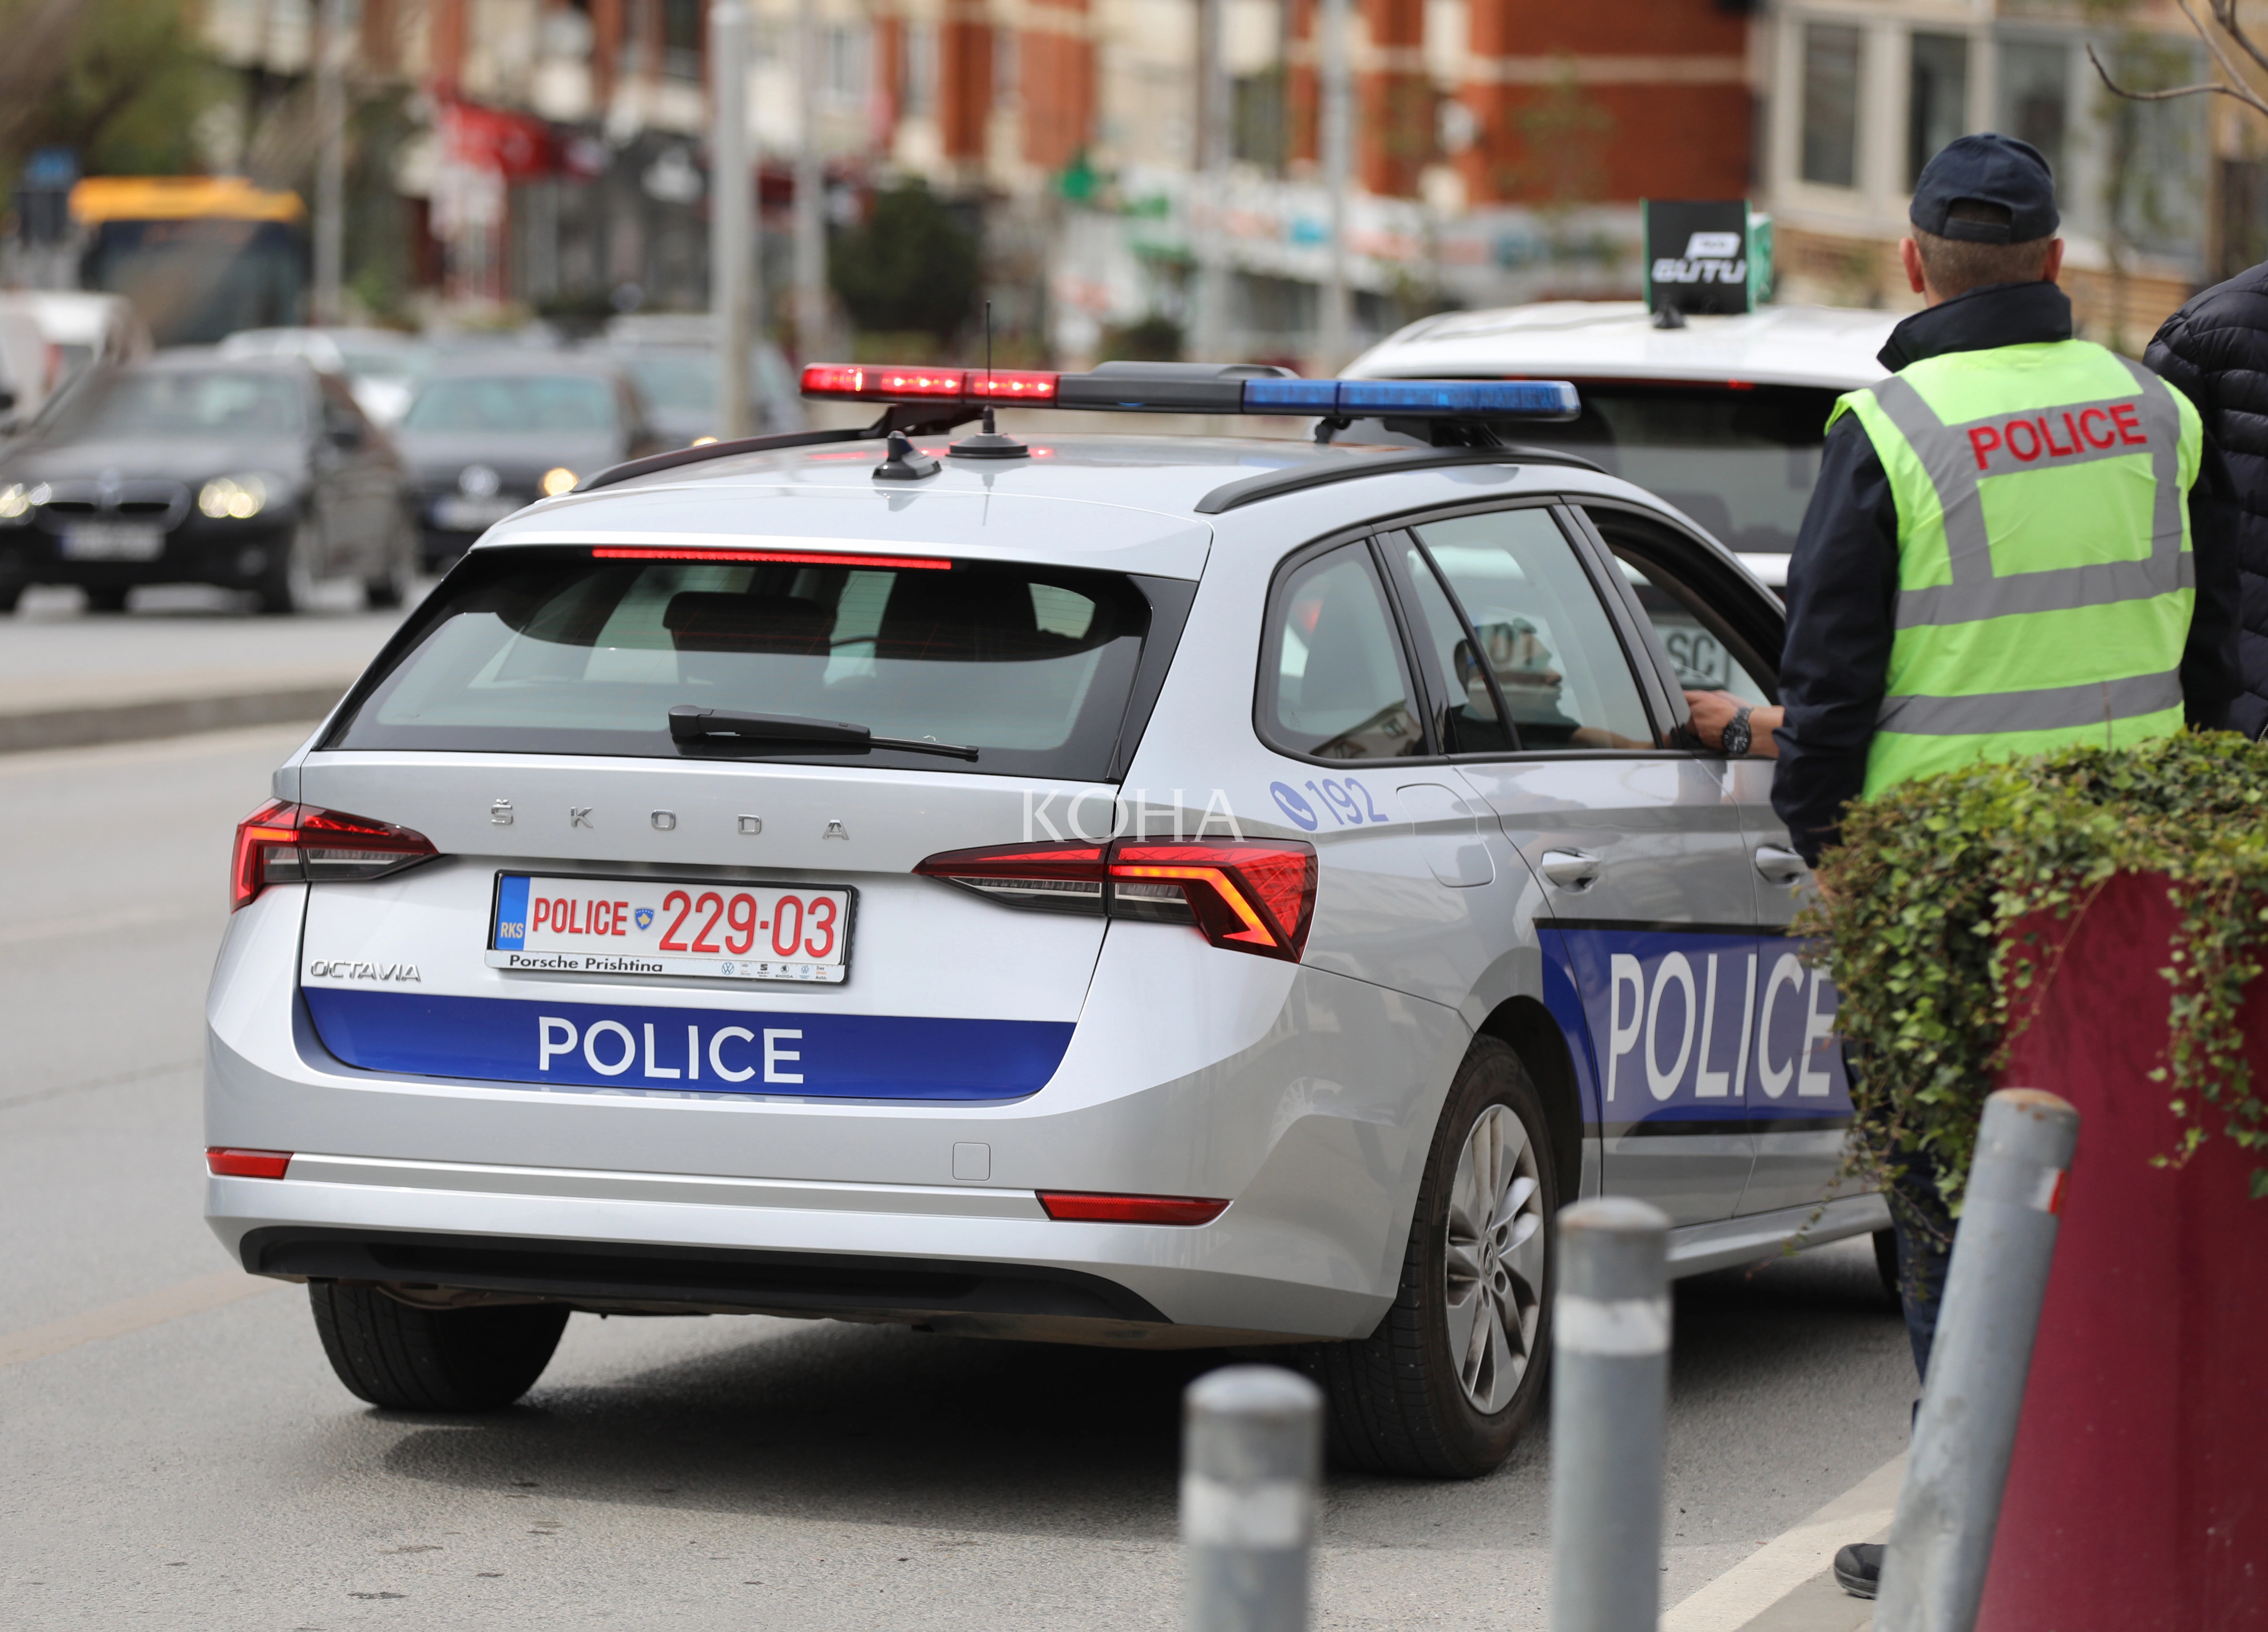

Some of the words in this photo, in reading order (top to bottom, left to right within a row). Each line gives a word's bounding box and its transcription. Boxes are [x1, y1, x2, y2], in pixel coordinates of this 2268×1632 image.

[1968, 403, 2147, 470] POLICE
[491, 798, 850, 841] ŠKODA
[1304, 777, 1389, 826] 192
[500, 921, 524, 939] RKS
[532, 897, 628, 936] POLICE
[659, 889, 837, 958] 229-03
[310, 958, 421, 982] OCTAVIA
[509, 954, 578, 970] Porsche
[585, 956, 663, 973] Prishtina
[538, 1016, 804, 1084] POLICE
[1607, 950, 1837, 1102] POLICE
